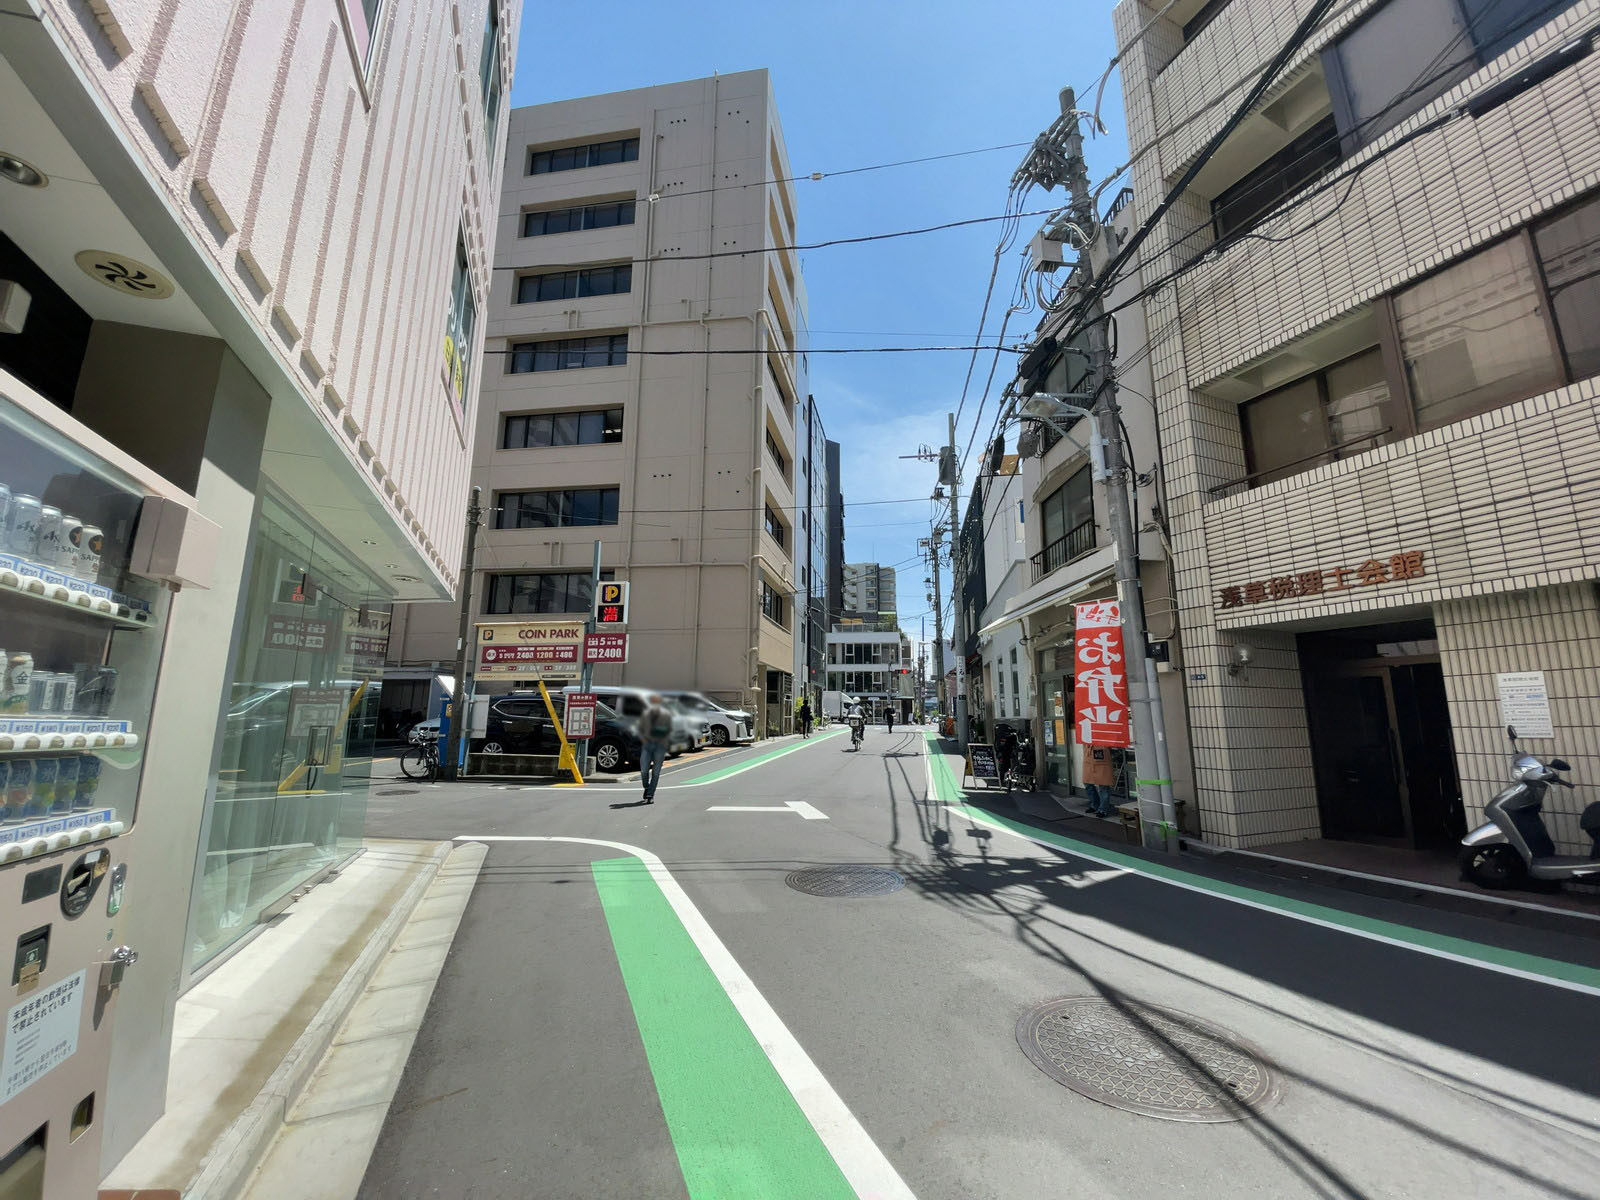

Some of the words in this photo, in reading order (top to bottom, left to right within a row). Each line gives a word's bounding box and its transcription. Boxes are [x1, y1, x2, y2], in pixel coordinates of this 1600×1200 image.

[518, 629, 547, 639] COIN
[549, 628, 579, 639] PARK
[598, 648, 622, 659] 2400
